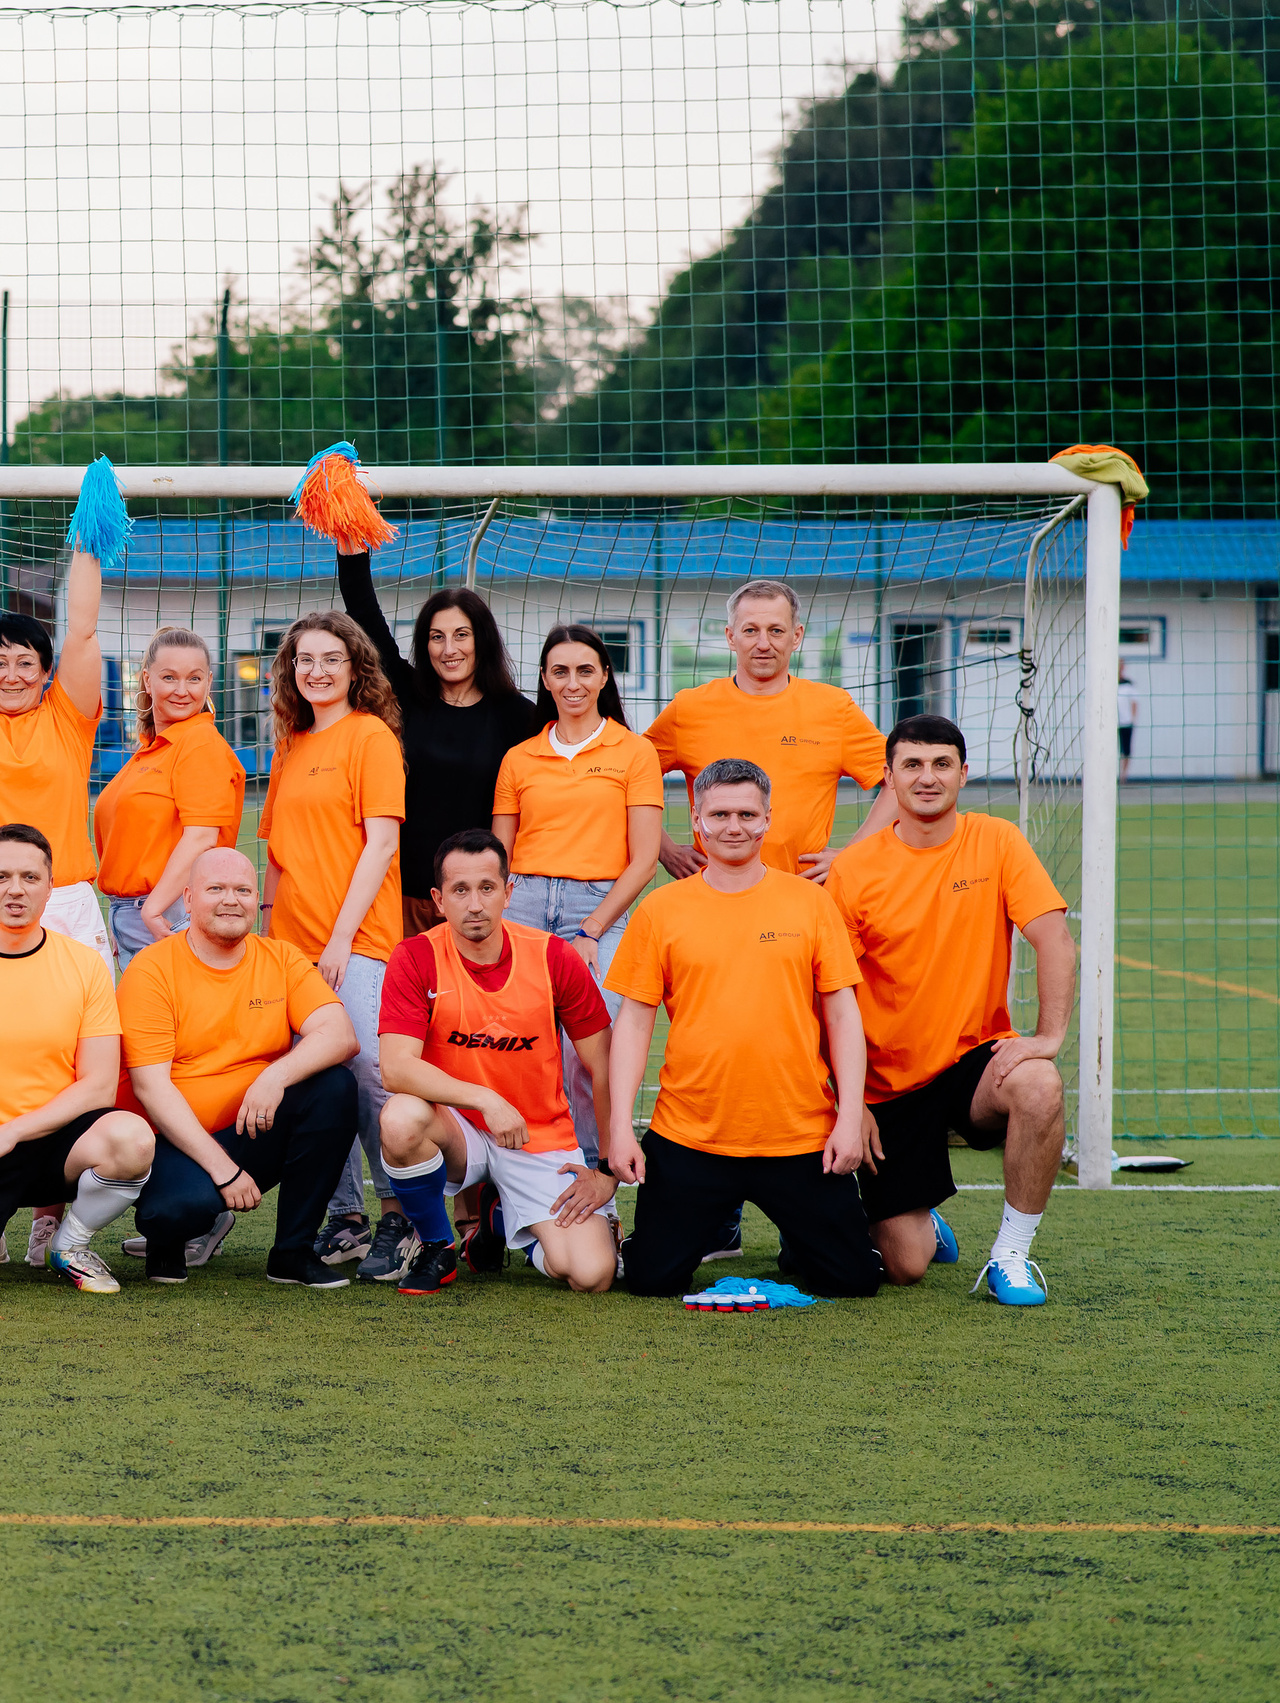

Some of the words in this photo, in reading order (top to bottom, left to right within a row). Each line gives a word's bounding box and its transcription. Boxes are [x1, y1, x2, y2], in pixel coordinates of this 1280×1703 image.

[781, 735, 796, 743] AR
[799, 738, 820, 746] GROUP
[586, 766, 601, 774] AR
[952, 879, 967, 889] AR
[760, 931, 775, 940] AR
[249, 998, 262, 1007] AR
[263, 997, 285, 1005] GROUP
[447, 1031, 539, 1051] DEMIX
